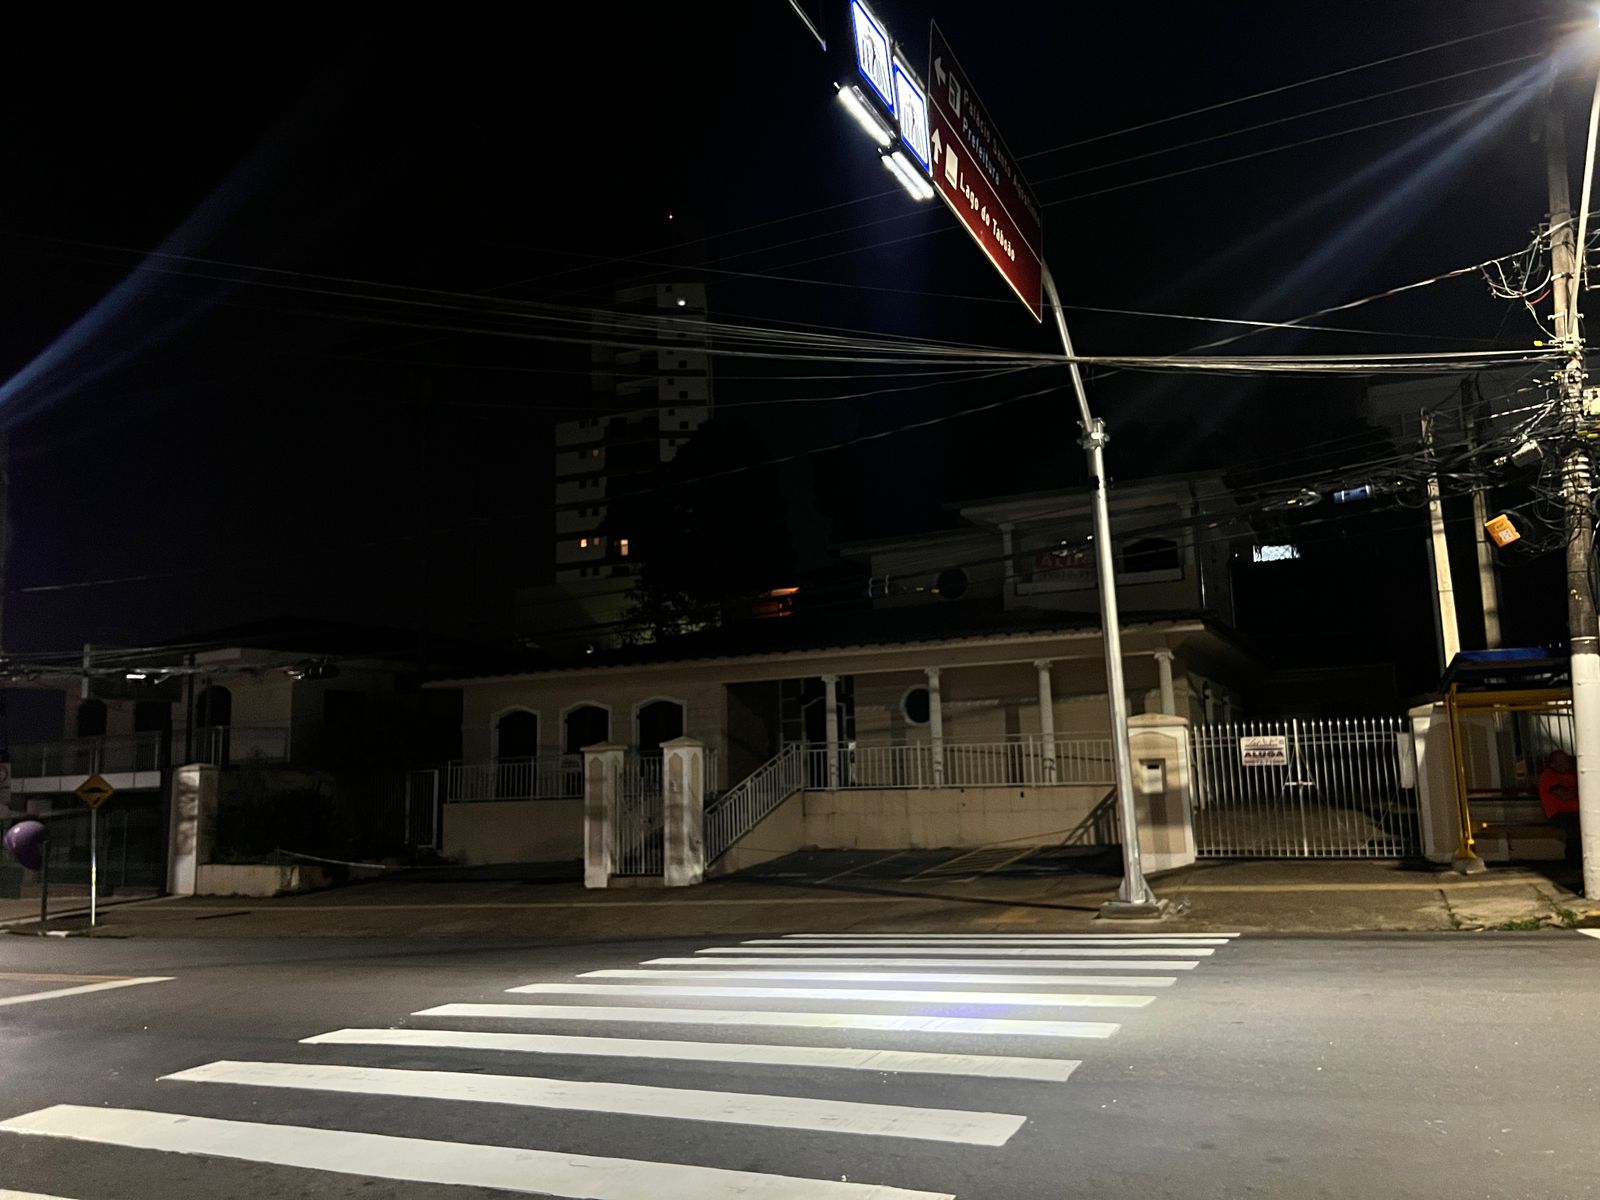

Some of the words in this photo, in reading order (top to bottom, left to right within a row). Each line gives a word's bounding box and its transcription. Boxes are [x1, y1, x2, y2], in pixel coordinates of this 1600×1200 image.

[962, 116, 999, 186] Prefeitura
[960, 172, 979, 211] Lago
[980, 204, 990, 227] do
[992, 218, 1015, 262] Taboão
